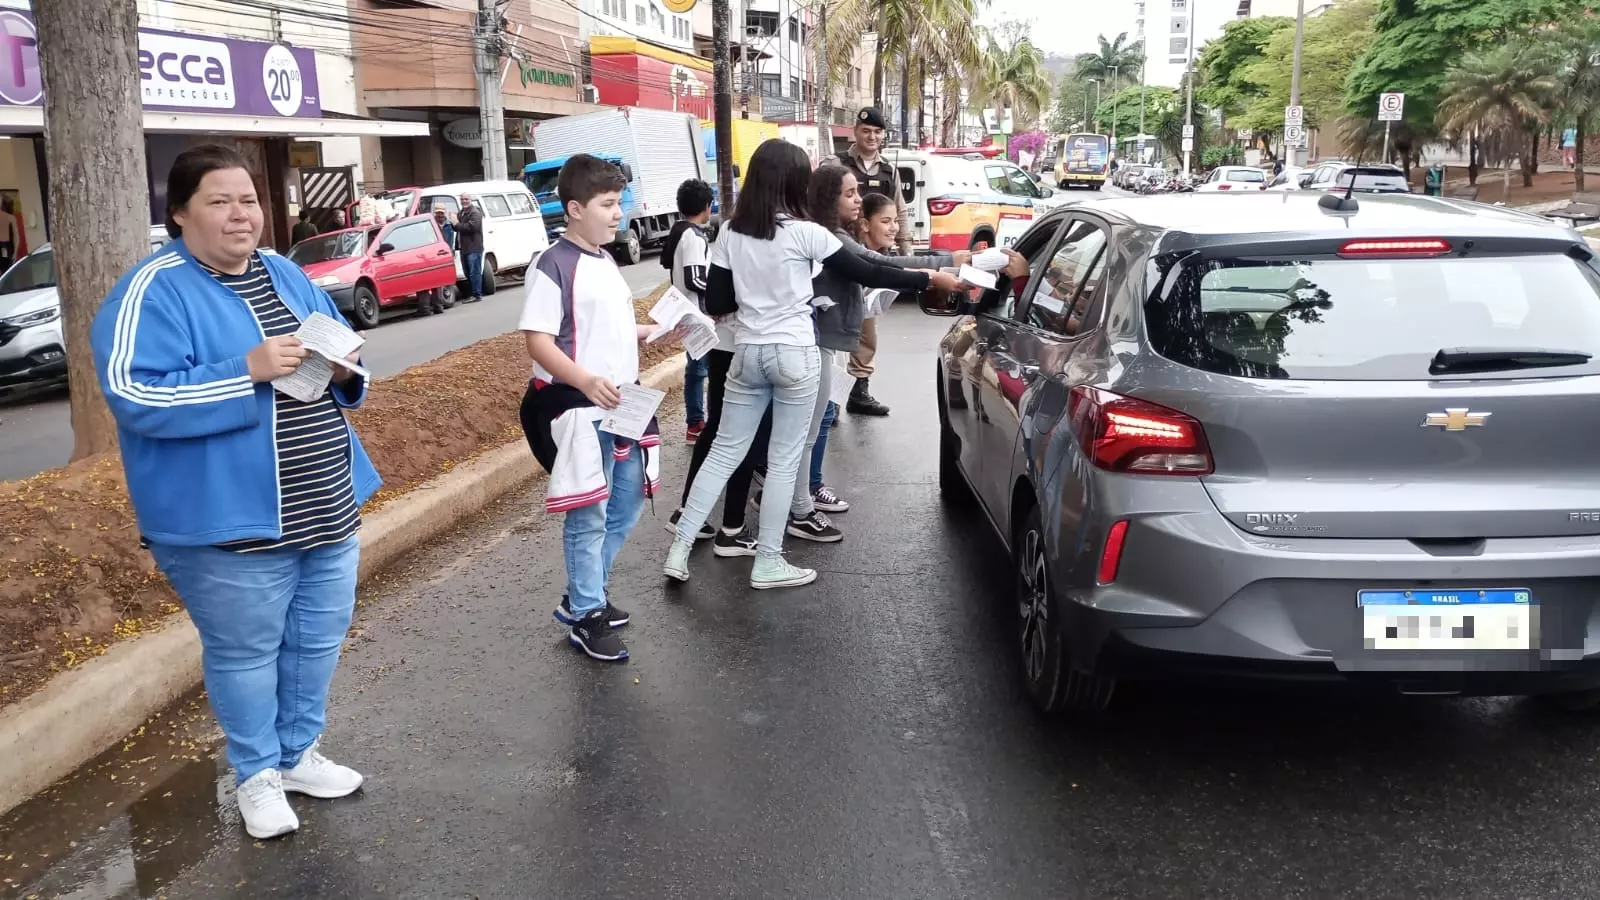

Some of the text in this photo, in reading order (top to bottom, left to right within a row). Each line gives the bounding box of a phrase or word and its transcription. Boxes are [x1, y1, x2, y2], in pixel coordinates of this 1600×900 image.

[138, 49, 226, 86] ecca
[1388, 97, 1396, 108] E
[1246, 513, 1298, 524] ONIX
[1431, 594, 1461, 604] BRASIL
